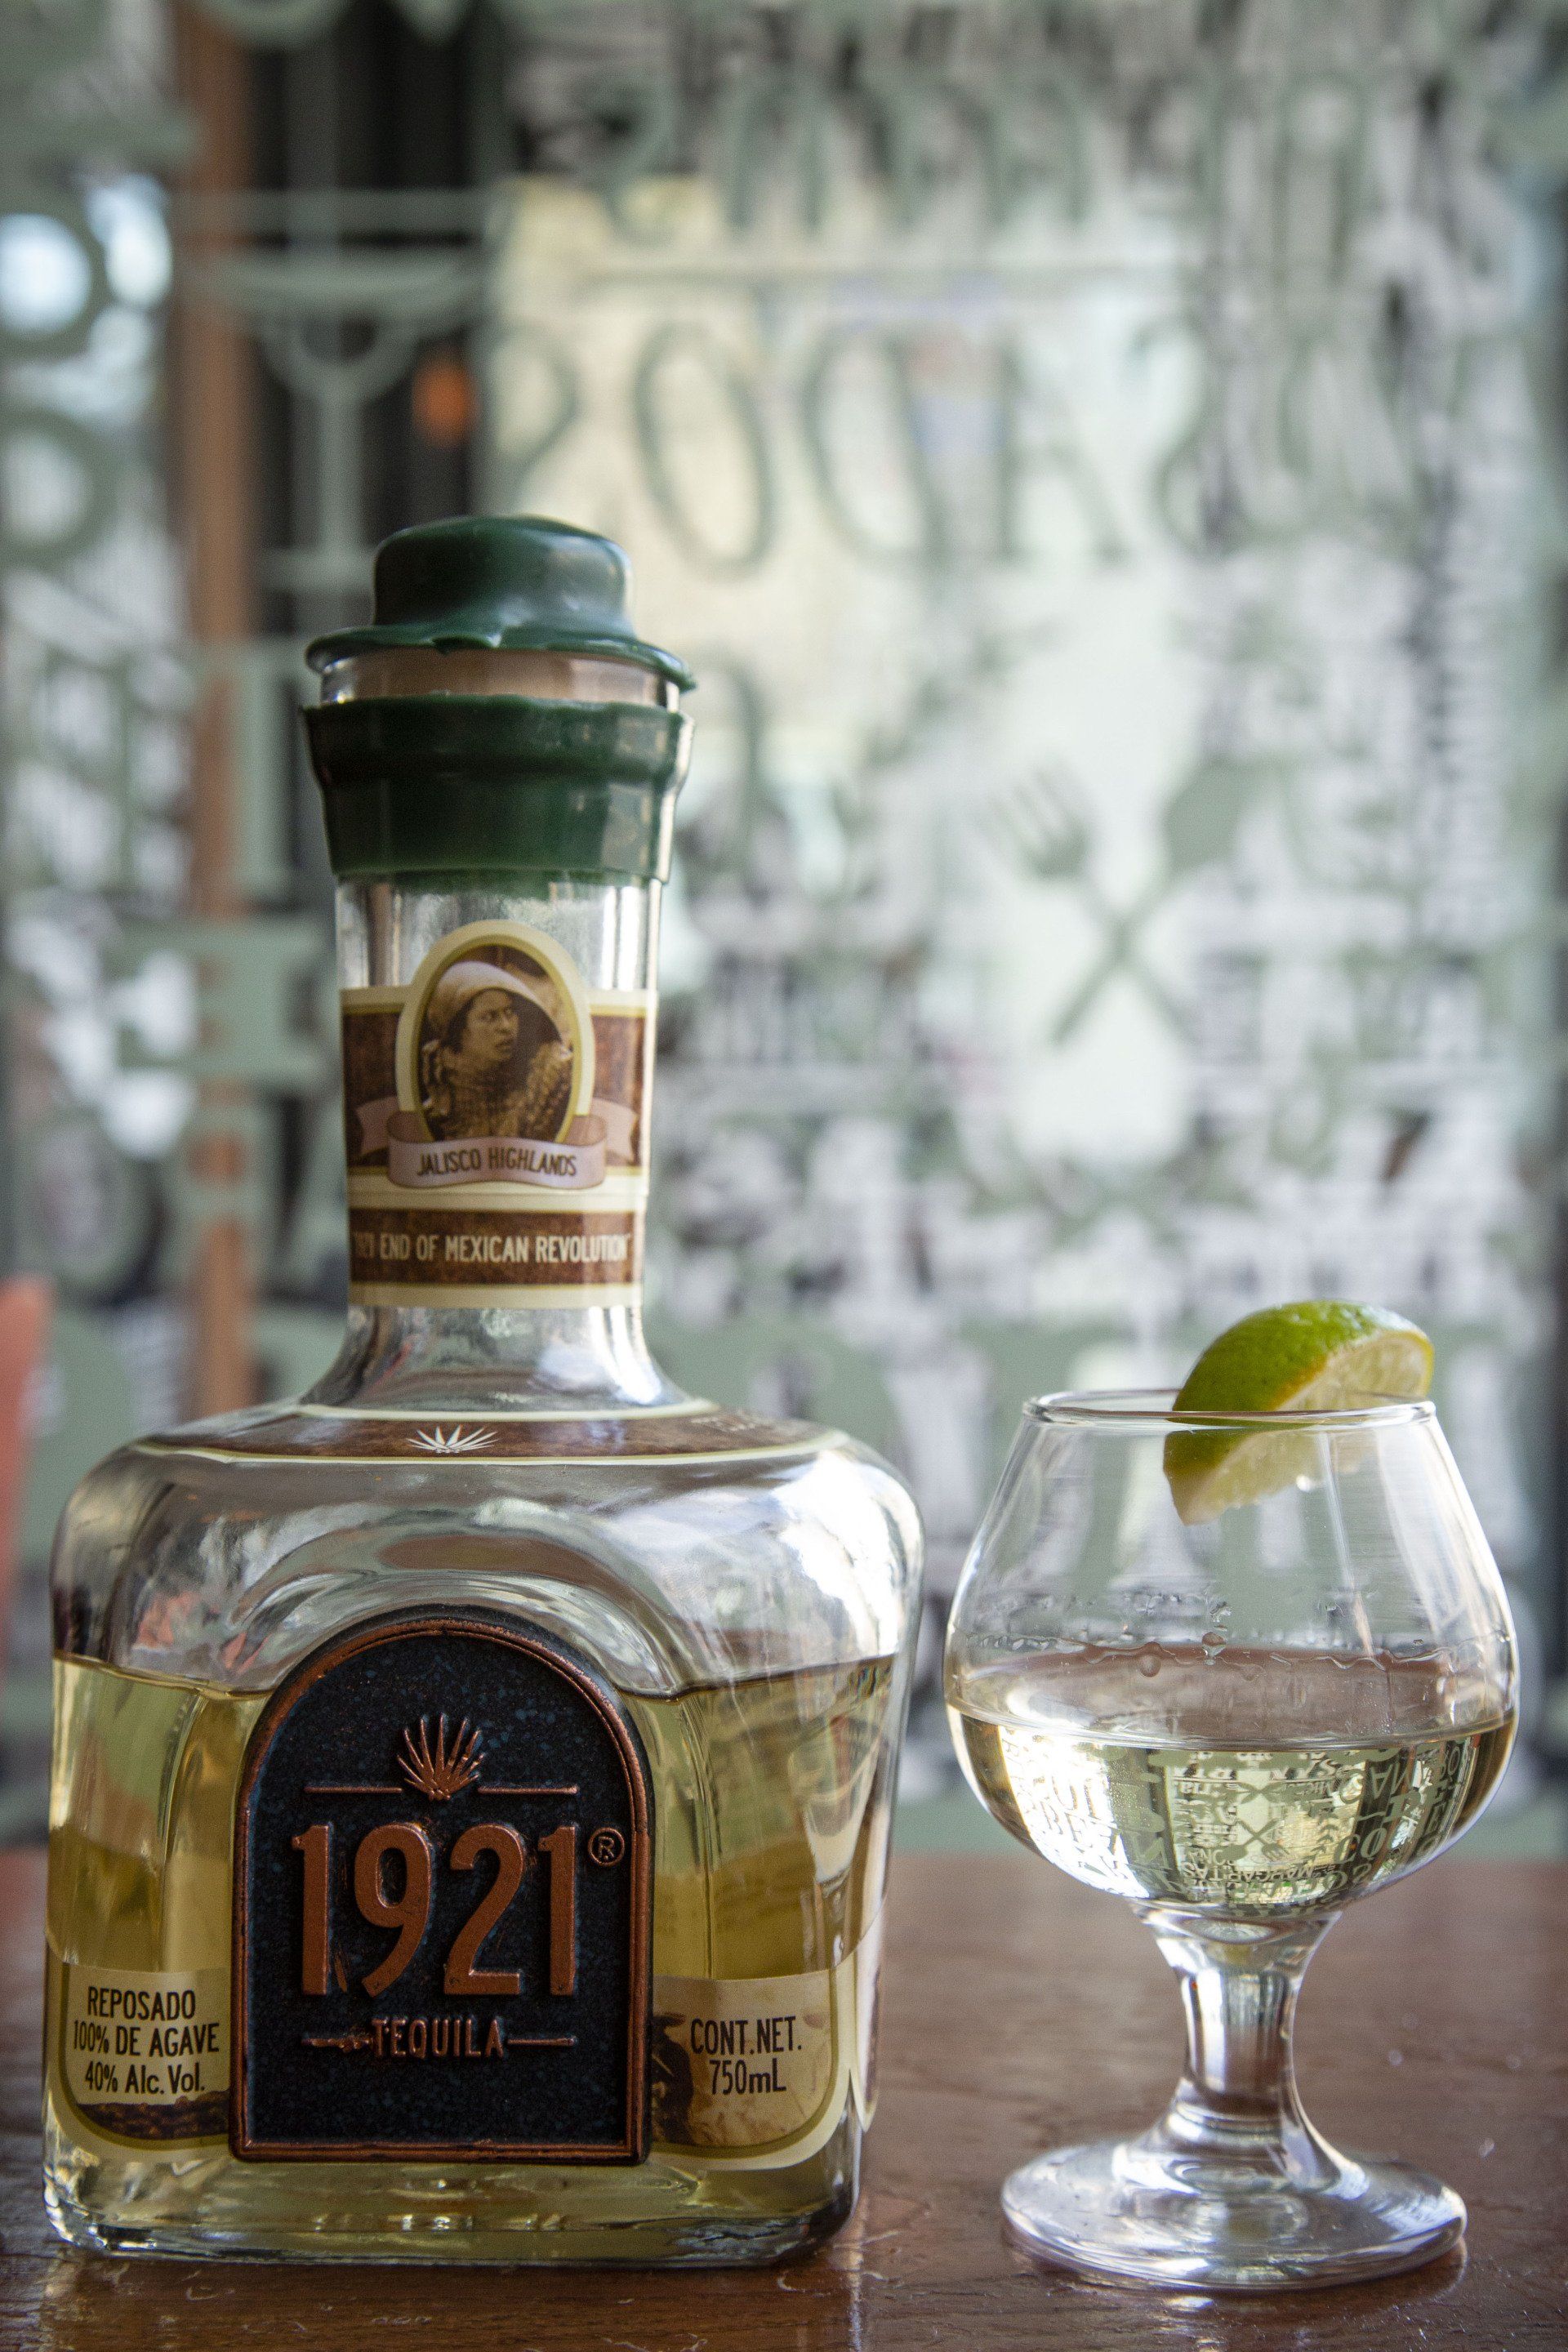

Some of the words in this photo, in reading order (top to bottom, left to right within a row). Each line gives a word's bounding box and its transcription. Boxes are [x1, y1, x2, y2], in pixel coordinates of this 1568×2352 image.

[417, 1147, 482, 1177] JALISCO
[488, 1146, 577, 1177] HIGHLANDS
[380, 1233, 409, 1260] END
[416, 1234, 439, 1261] OF
[445, 1234, 529, 1263] MEXICAN
[292, 1822, 578, 1998] 1921
[87, 1985, 196, 2021] REPOSADO
[74, 2020, 109, 2054] 100%
[115, 2025, 140, 2056] DE
[149, 2022, 220, 2057] AGAVE
[372, 2017, 503, 2059] TEQUILA
[85, 2060, 118, 2092] 40%
[125, 2064, 164, 2095] Alc.
[168, 2062, 205, 2094] Vol.
[709, 2058, 786, 2095] 750mL
